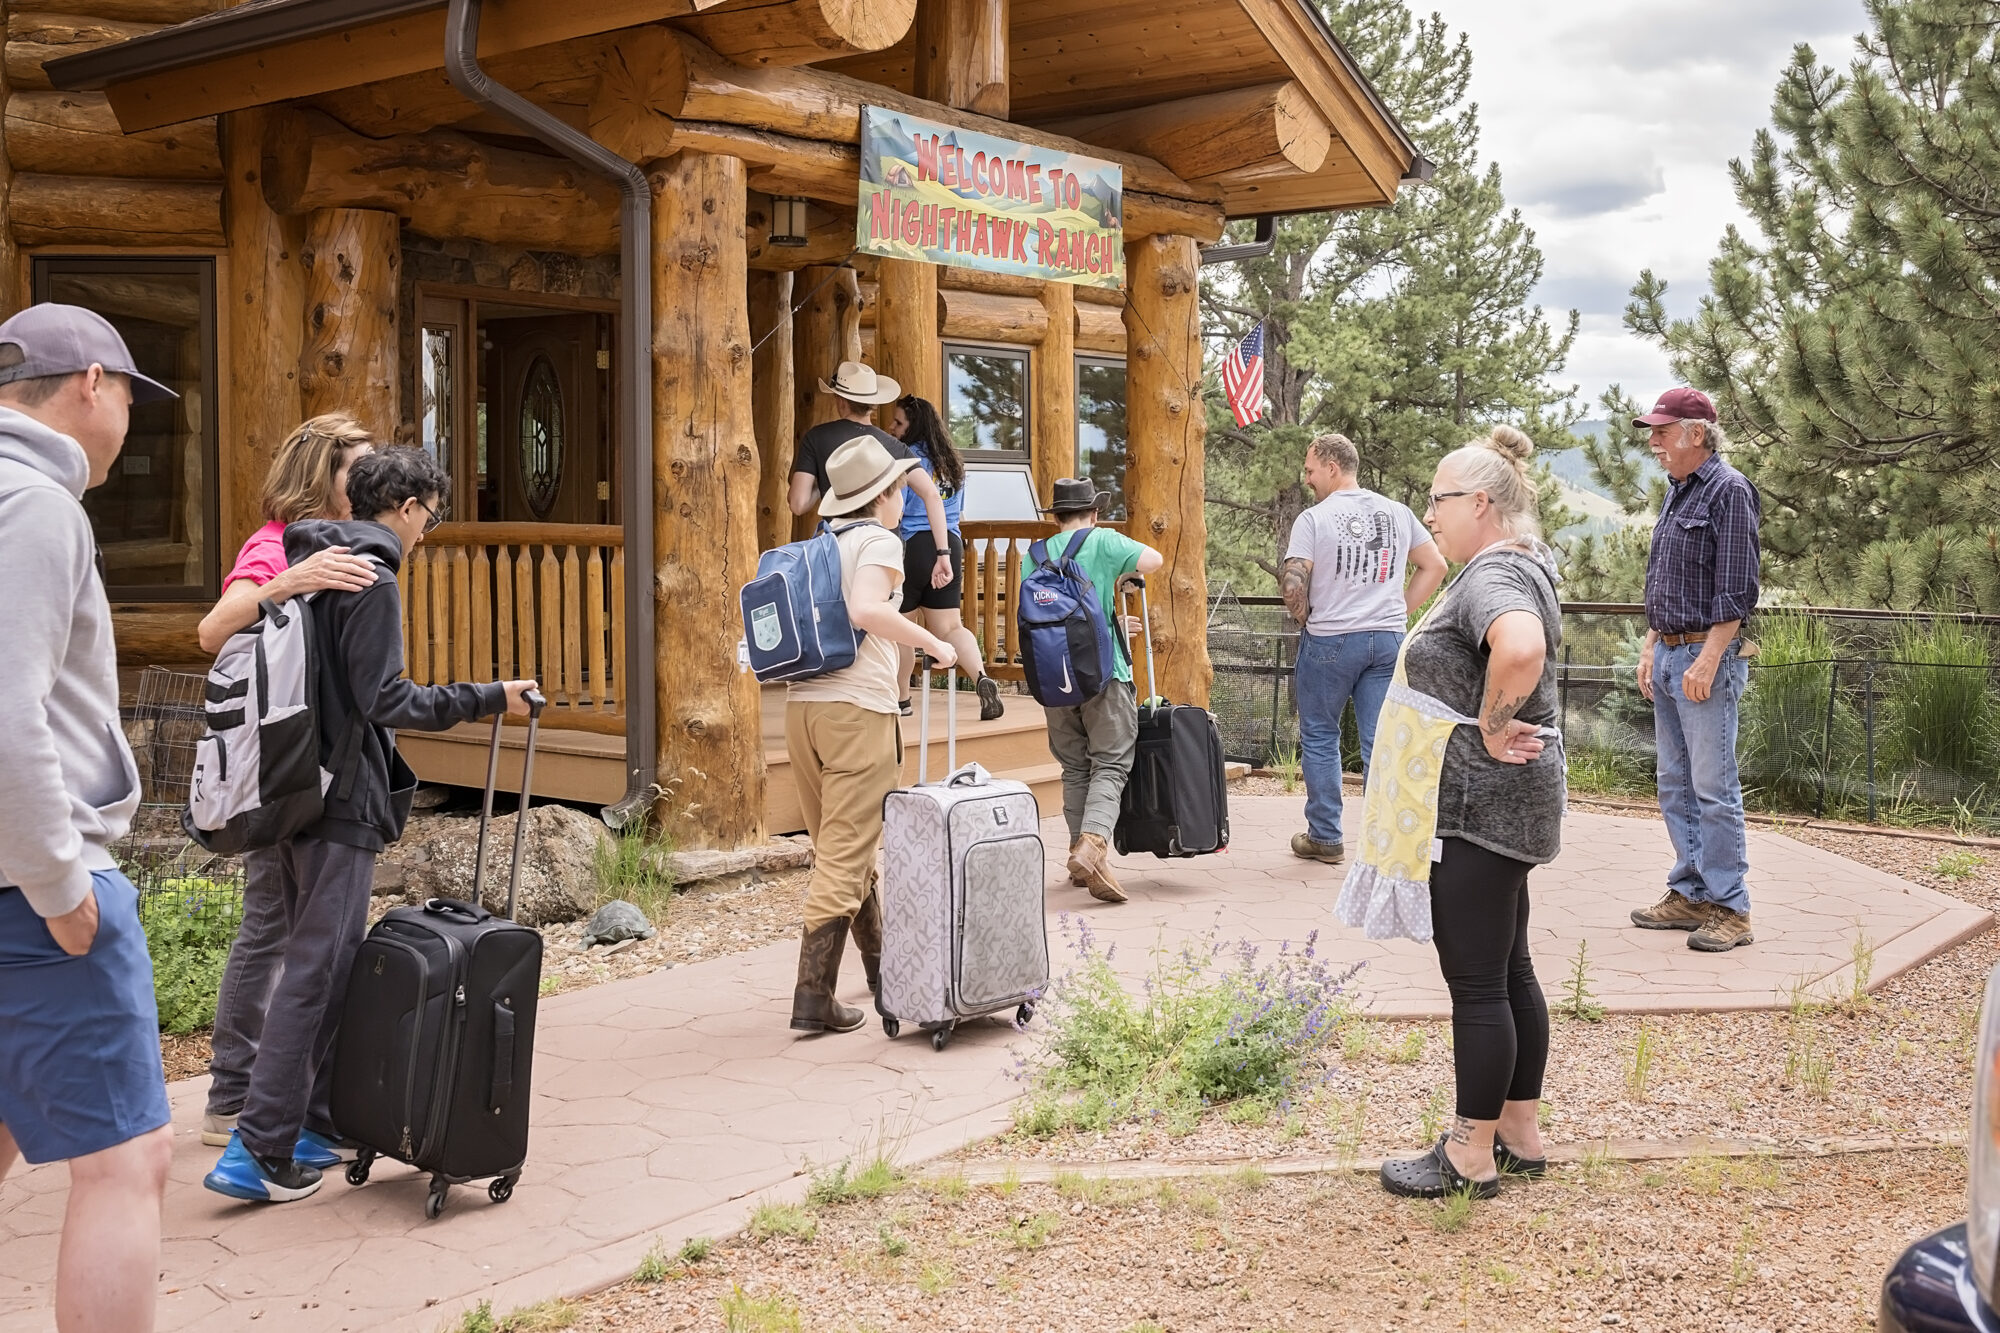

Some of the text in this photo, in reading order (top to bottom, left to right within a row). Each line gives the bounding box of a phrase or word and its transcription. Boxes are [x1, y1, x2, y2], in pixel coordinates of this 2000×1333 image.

[913, 133, 1081, 211] WELCOME TO
[870, 189, 1113, 275] NIGHTHAWK RANCH
[1033, 591, 1058, 601] KICKIN
